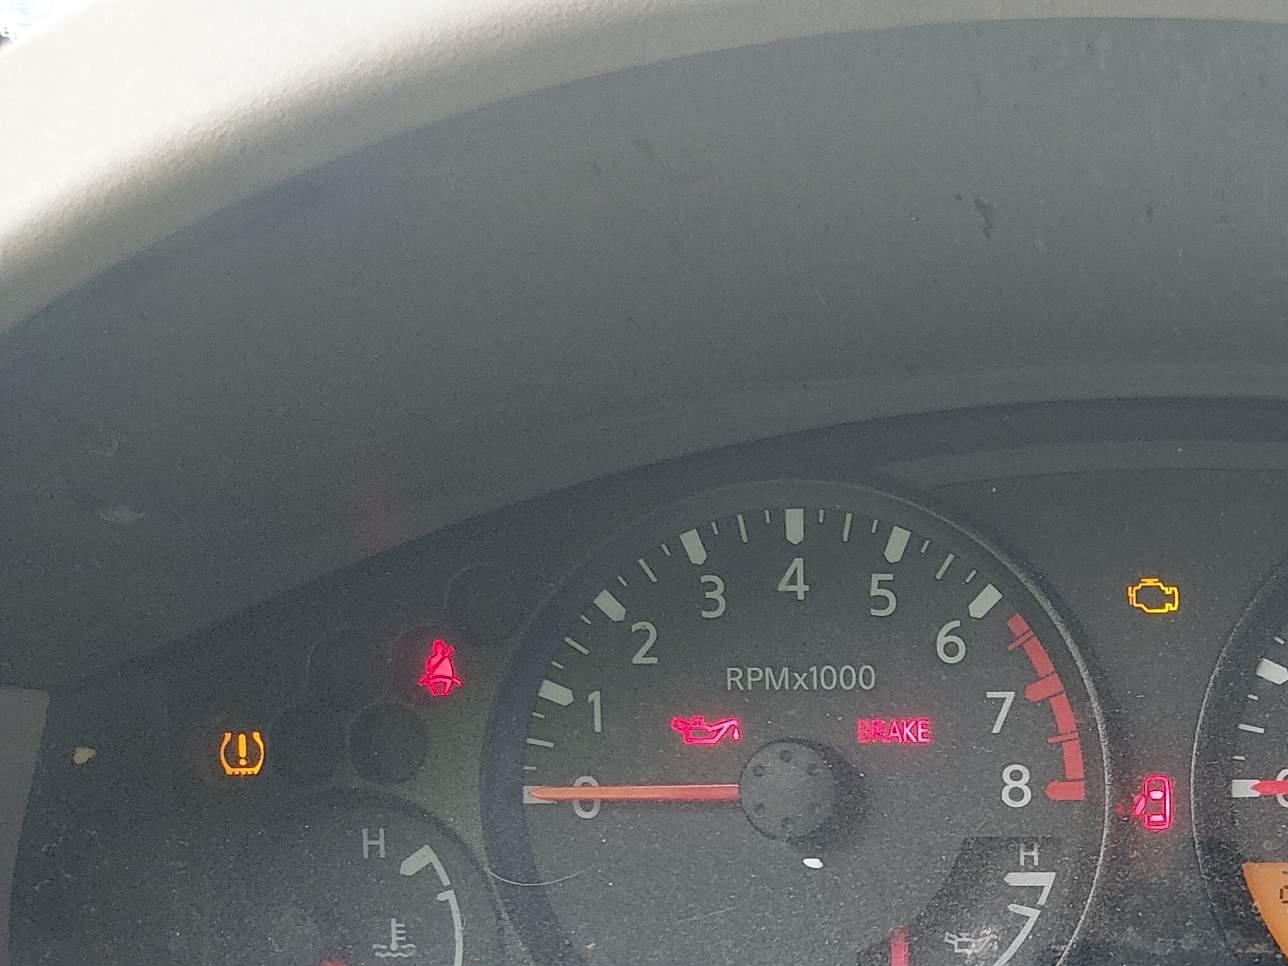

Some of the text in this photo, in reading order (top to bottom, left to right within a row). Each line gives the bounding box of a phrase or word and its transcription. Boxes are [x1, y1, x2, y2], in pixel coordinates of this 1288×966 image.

[701, 575, 726, 618] 3
[778, 558, 809, 600] 4
[870, 574, 896, 617] 5
[632, 622, 658, 664] 2
[936, 621, 966, 664] 6
[727, 666, 876, 691] RPMx1000
[588, 691, 601, 732] 1
[858, 719, 930, 743] BRAKE
[986, 691, 1015, 733] 7
[1002, 765, 1032, 807] 8
[363, 828, 386, 858] H
[1020, 845, 1039, 866] H
